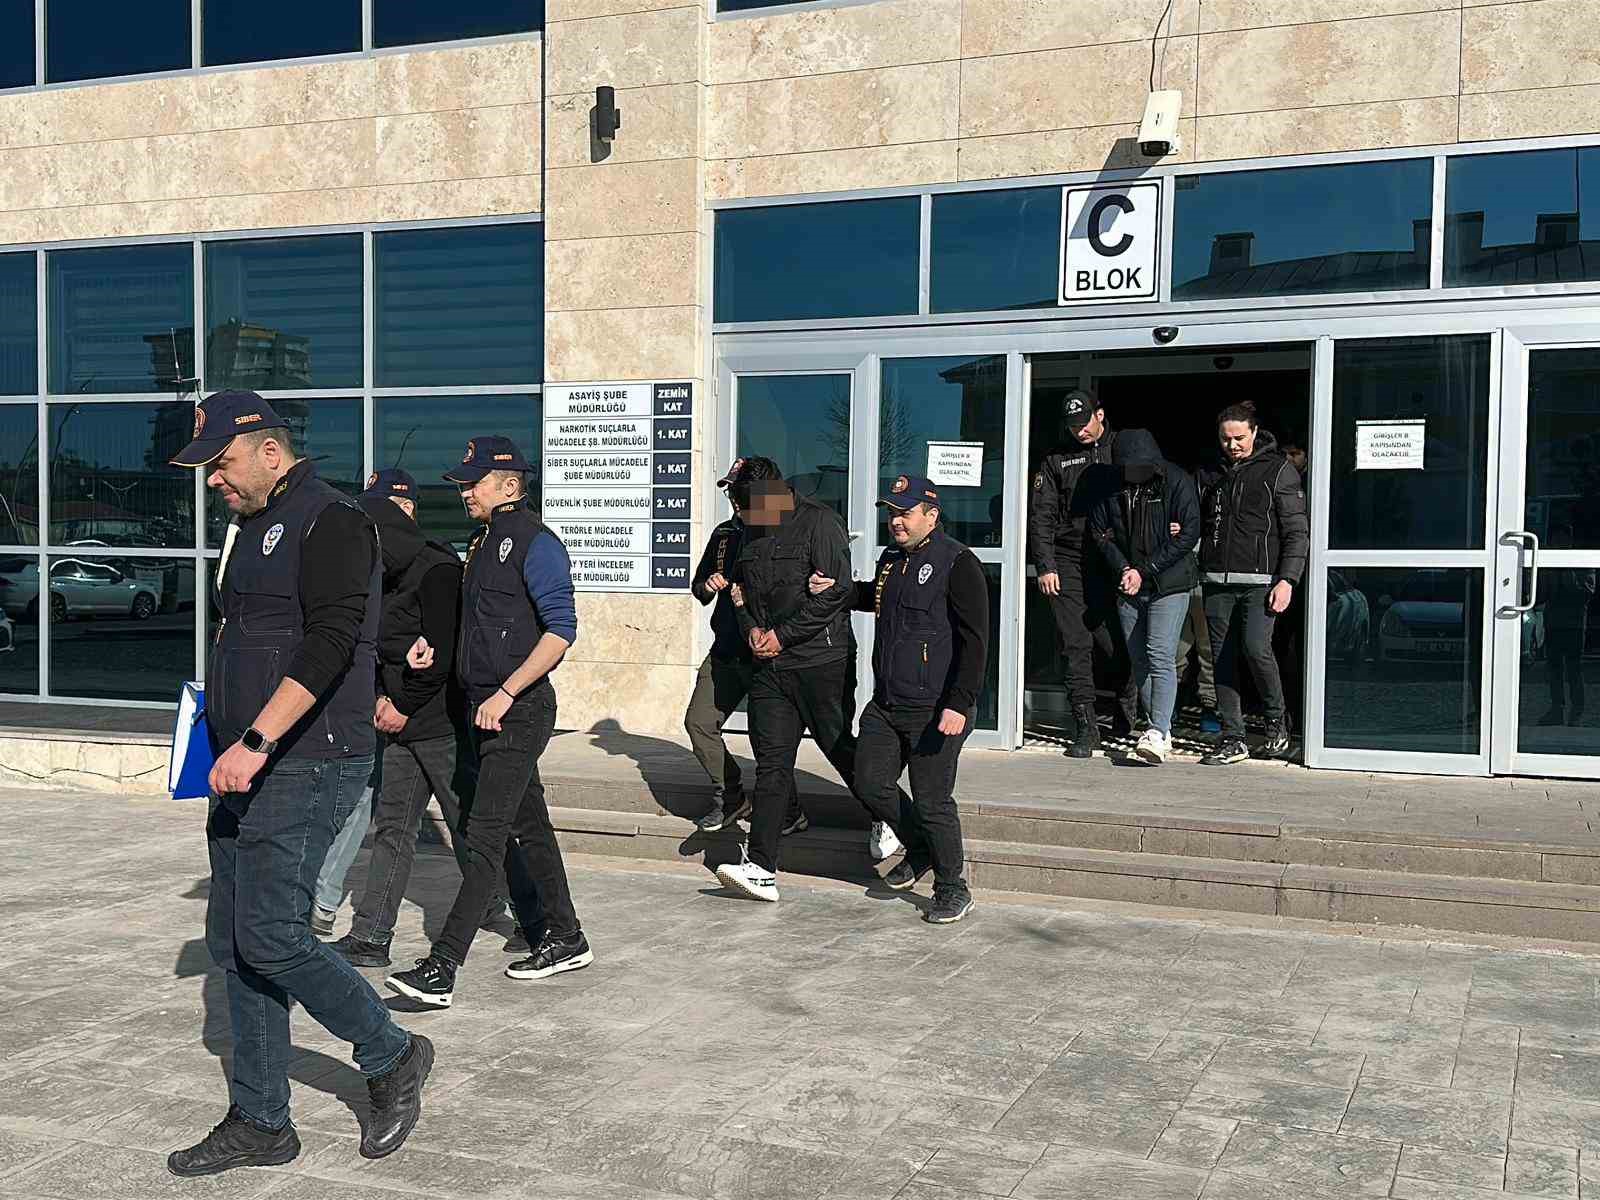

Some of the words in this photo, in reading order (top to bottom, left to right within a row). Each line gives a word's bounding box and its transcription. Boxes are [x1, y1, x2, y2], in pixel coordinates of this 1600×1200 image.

[1087, 194, 1135, 257] C
[1076, 267, 1141, 291] BLOK
[568, 390, 600, 401] ASAYİŞ
[603, 390, 628, 401] ŞUBE
[657, 386, 688, 399] ZEMİN
[568, 402, 626, 413] MÜDÜRLÜĞÜ
[663, 402, 683, 412] KAT
[559, 423, 597, 433] NARKOTİK
[598, 423, 637, 434] SUÇLARLA
[657, 429, 666, 440] 1.
[668, 429, 688, 439] KAT
[548, 436, 586, 446] MÜCADELE
[588, 437, 600, 447] ŞB.
[601, 435, 648, 446] MÜDÜRLÜĞÜ
[547, 457, 568, 467] SİBER
[569, 457, 607, 468] SUÇLARLA
[609, 456, 649, 467] MÜCADELE
[657, 464, 666, 474] 1.
[667, 463, 687, 474] KAT
[564, 471, 583, 480] ŞUBE
[584, 469, 631, 480] MÜDÜRLÜĞÜ
[545, 496, 581, 507] GÜVENLİK
[583, 498, 602, 508] ŞUBE
[603, 497, 650, 508] MÜDÜRLÜĞÜ
[656, 499, 666, 508] 2.
[667, 498, 687, 508] KAT
[560, 525, 592, 535] TERÖRLE
[594, 524, 634, 535] MÜCADELE
[584, 537, 630, 548] MÜDÜRLÜĞÜ
[656, 533, 665, 543] 2.
[667, 533, 687, 543] KAT
[579, 558, 596, 568] YERİ
[597, 558, 635, 569] İNCELEME
[572, 573, 582, 581] BE
[583, 571, 630, 582] MÜDÜRLÜĞÜ
[656, 567, 665, 577] 3.
[666, 567, 687, 577] KAT
